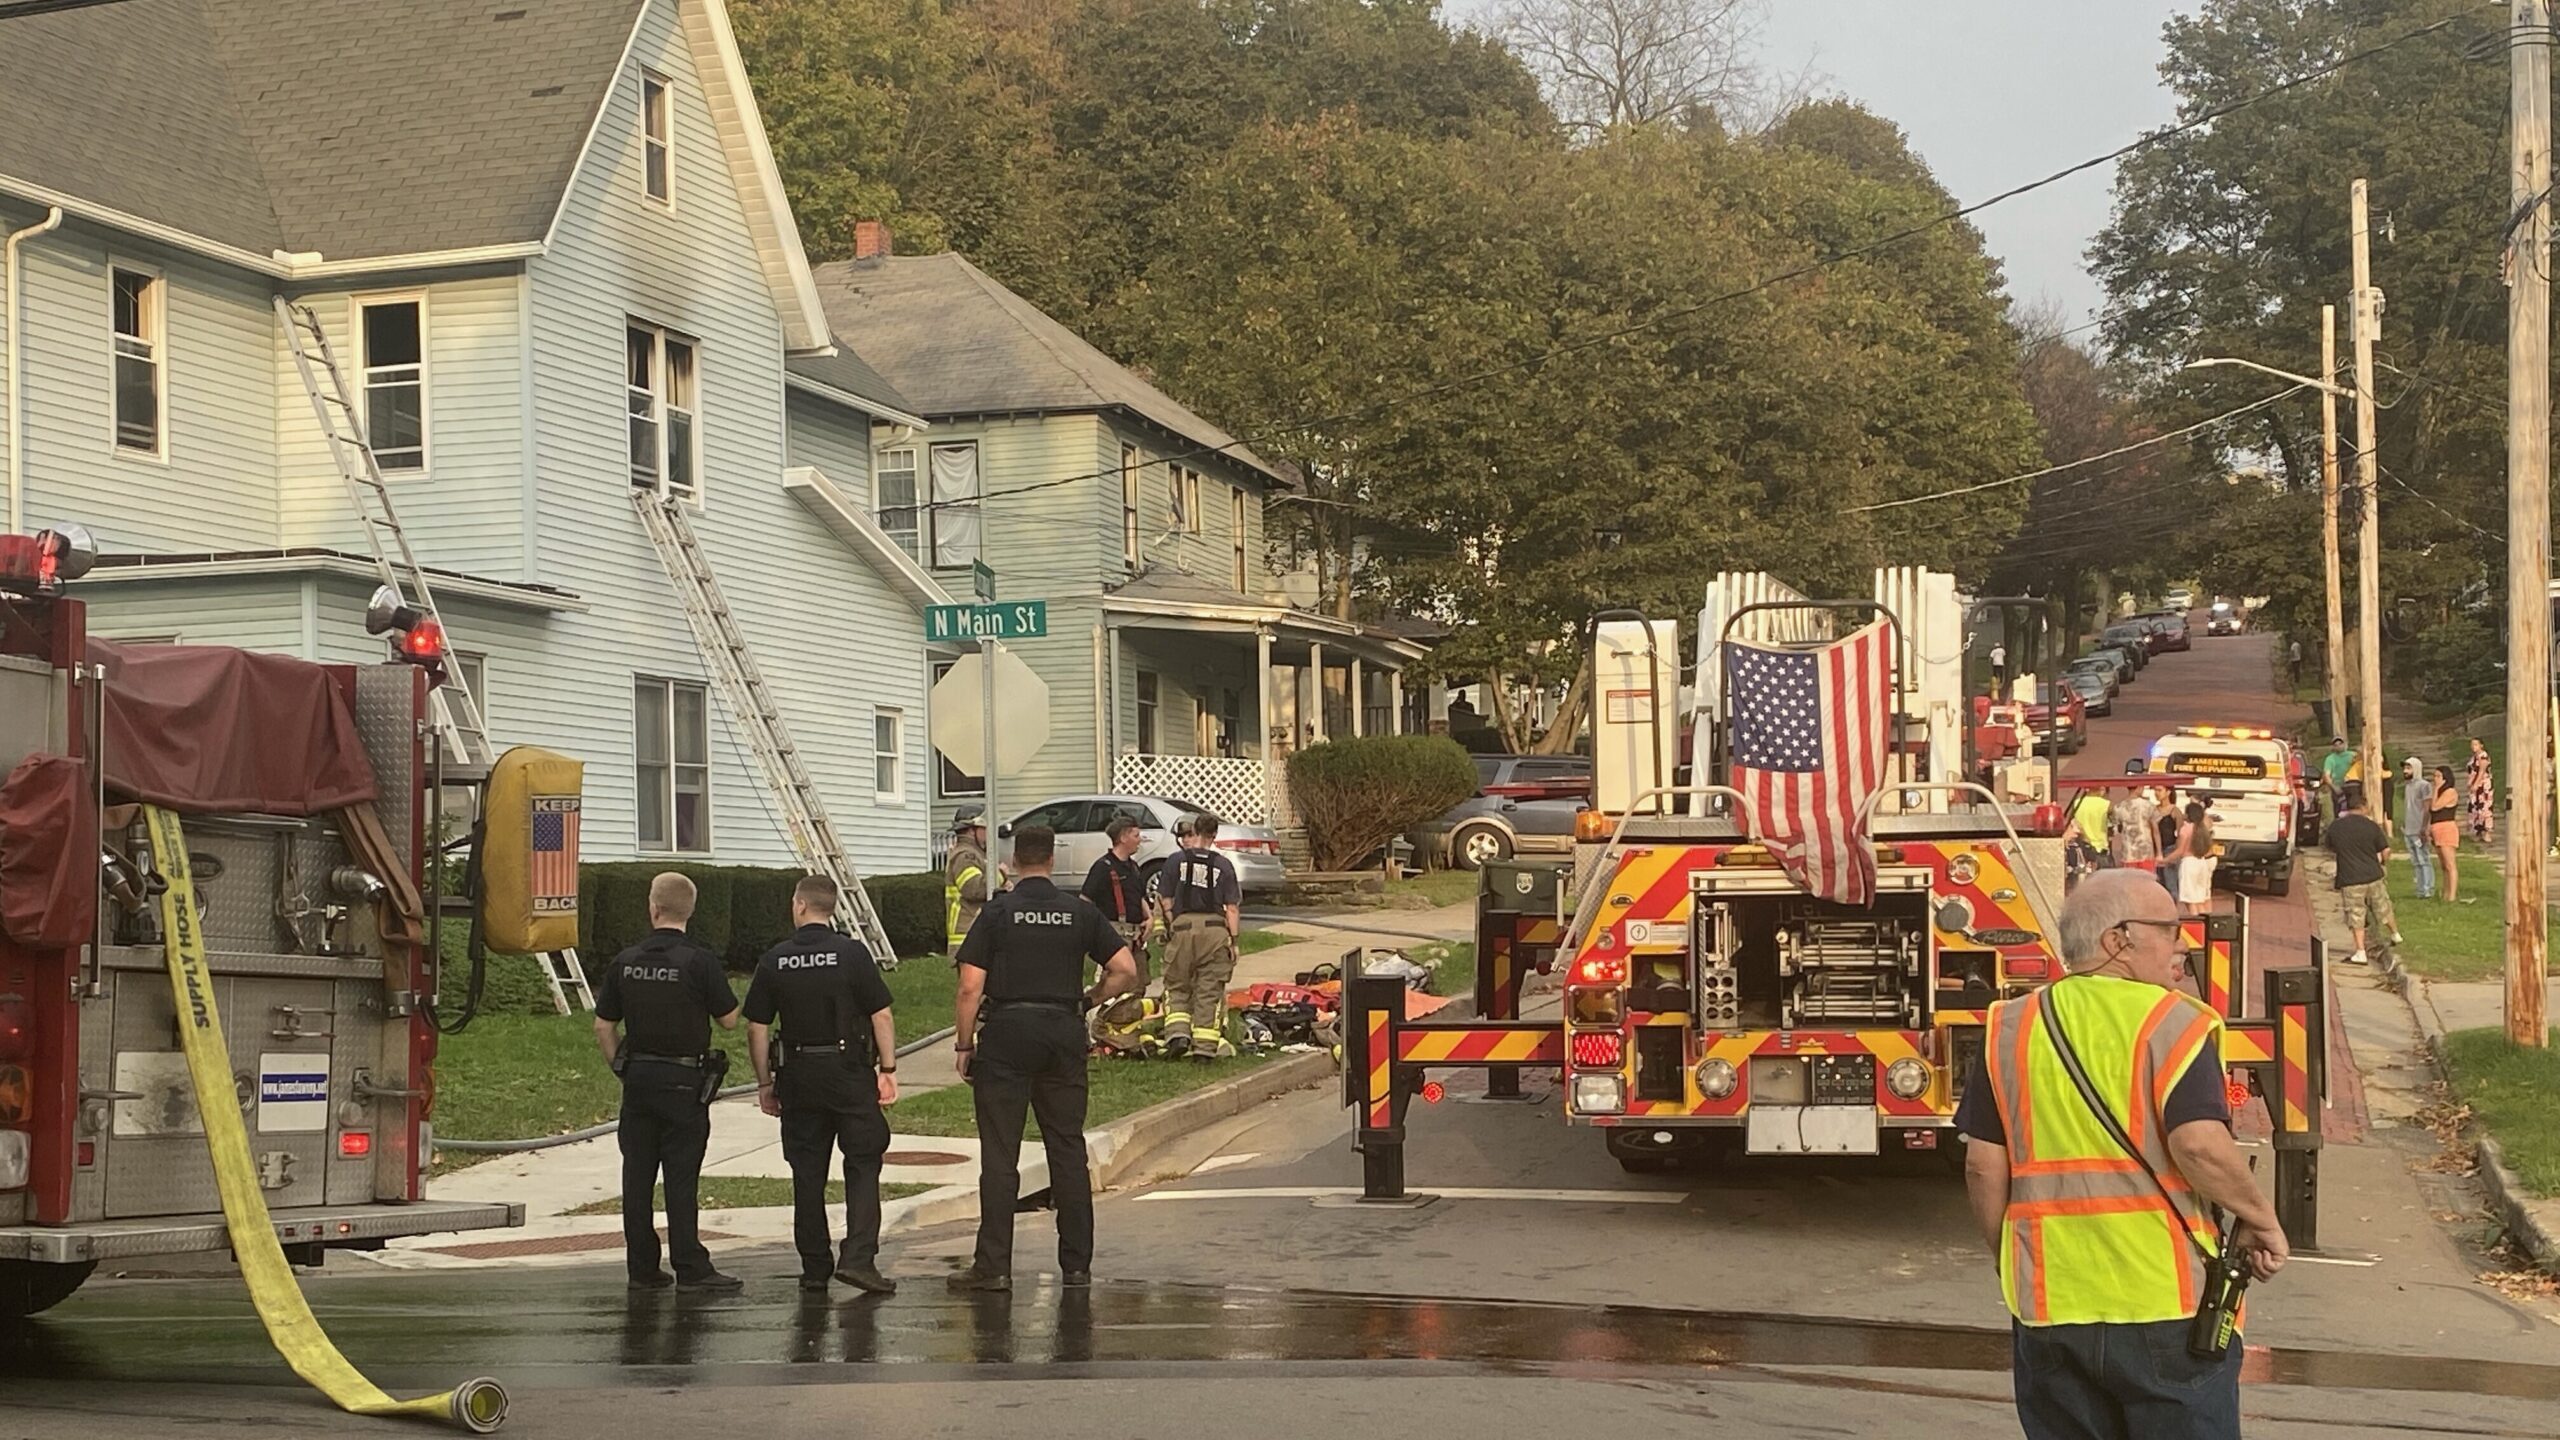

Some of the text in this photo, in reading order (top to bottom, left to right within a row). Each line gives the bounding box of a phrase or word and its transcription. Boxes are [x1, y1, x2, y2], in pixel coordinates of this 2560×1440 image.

[934, 606, 1036, 636] N Main St
[2173, 764, 2259, 775] FIRE DEPARTMENT
[534, 800, 580, 811] KEEP
[533, 898, 577, 910] BACK
[1014, 911, 1072, 926] POLICE
[174, 893, 210, 1029] SUPPLY HOSE
[778, 953, 838, 970] POLICE
[623, 966, 679, 982] POLICE
